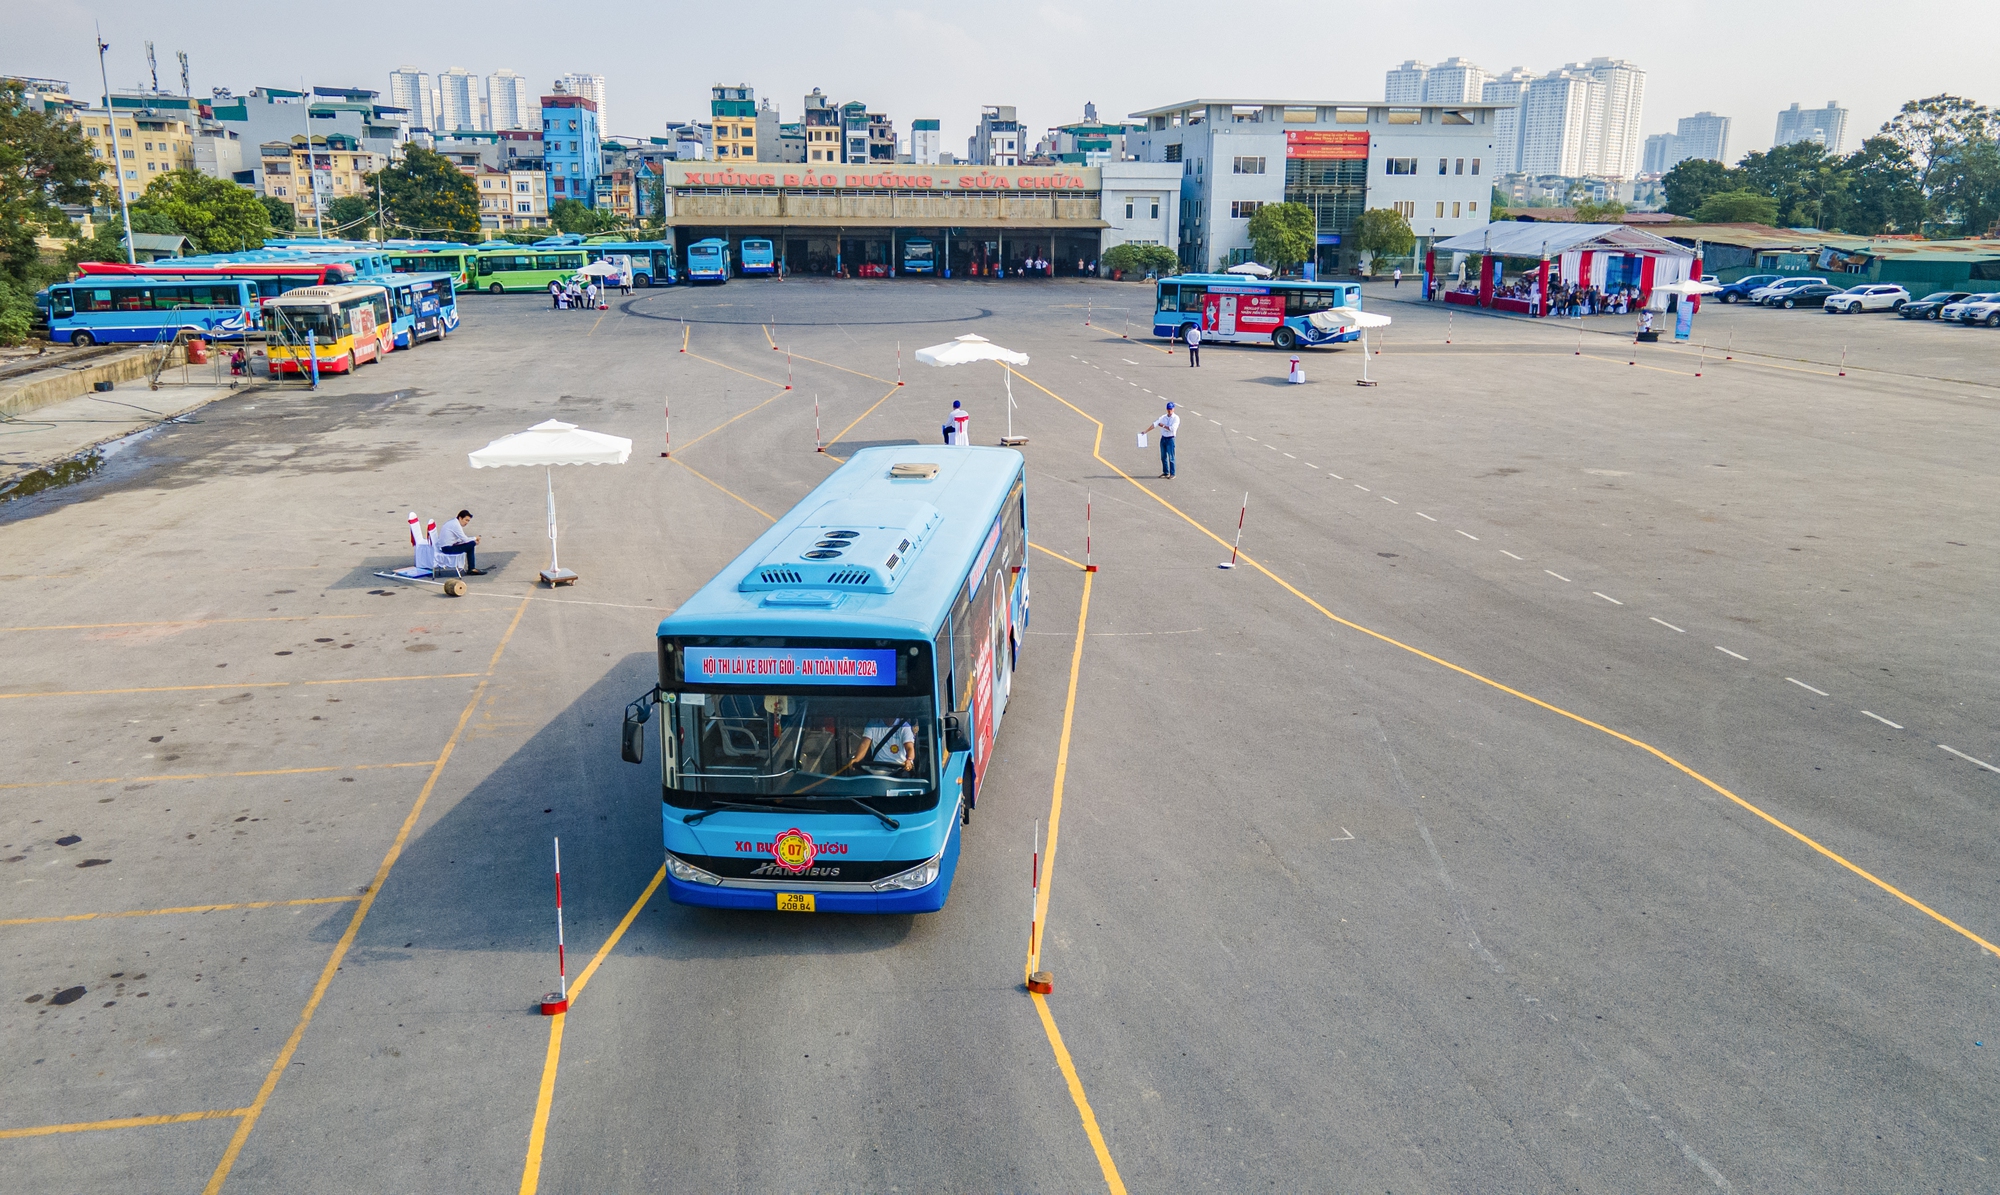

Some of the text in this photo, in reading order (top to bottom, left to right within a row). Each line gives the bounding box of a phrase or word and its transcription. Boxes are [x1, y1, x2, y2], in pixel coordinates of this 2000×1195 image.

[685, 167, 775, 186] XƯỞNG
[784, 169, 838, 187] BẢO
[846, 171, 933, 188] DƯỠNG
[959, 170, 1011, 188] SỬA
[1018, 173, 1085, 189] CHỮA
[703, 656, 716, 677] HỘI
[718, 658, 729, 674] THI
[732, 656, 744, 674] LÁI
[746, 659, 756, 674] XE
[758, 656, 777, 674] BUÝT
[779, 654, 795, 675] GIỎI
[802, 660, 813, 675] AN
[815, 656, 835, 675] TOÀN
[837, 657, 856, 676] NĂM
[857, 661, 877, 676] 2024
[788, 844, 802, 855] 07
[787, 894, 804, 902] 29B
[781, 903, 811, 911] 208.84
